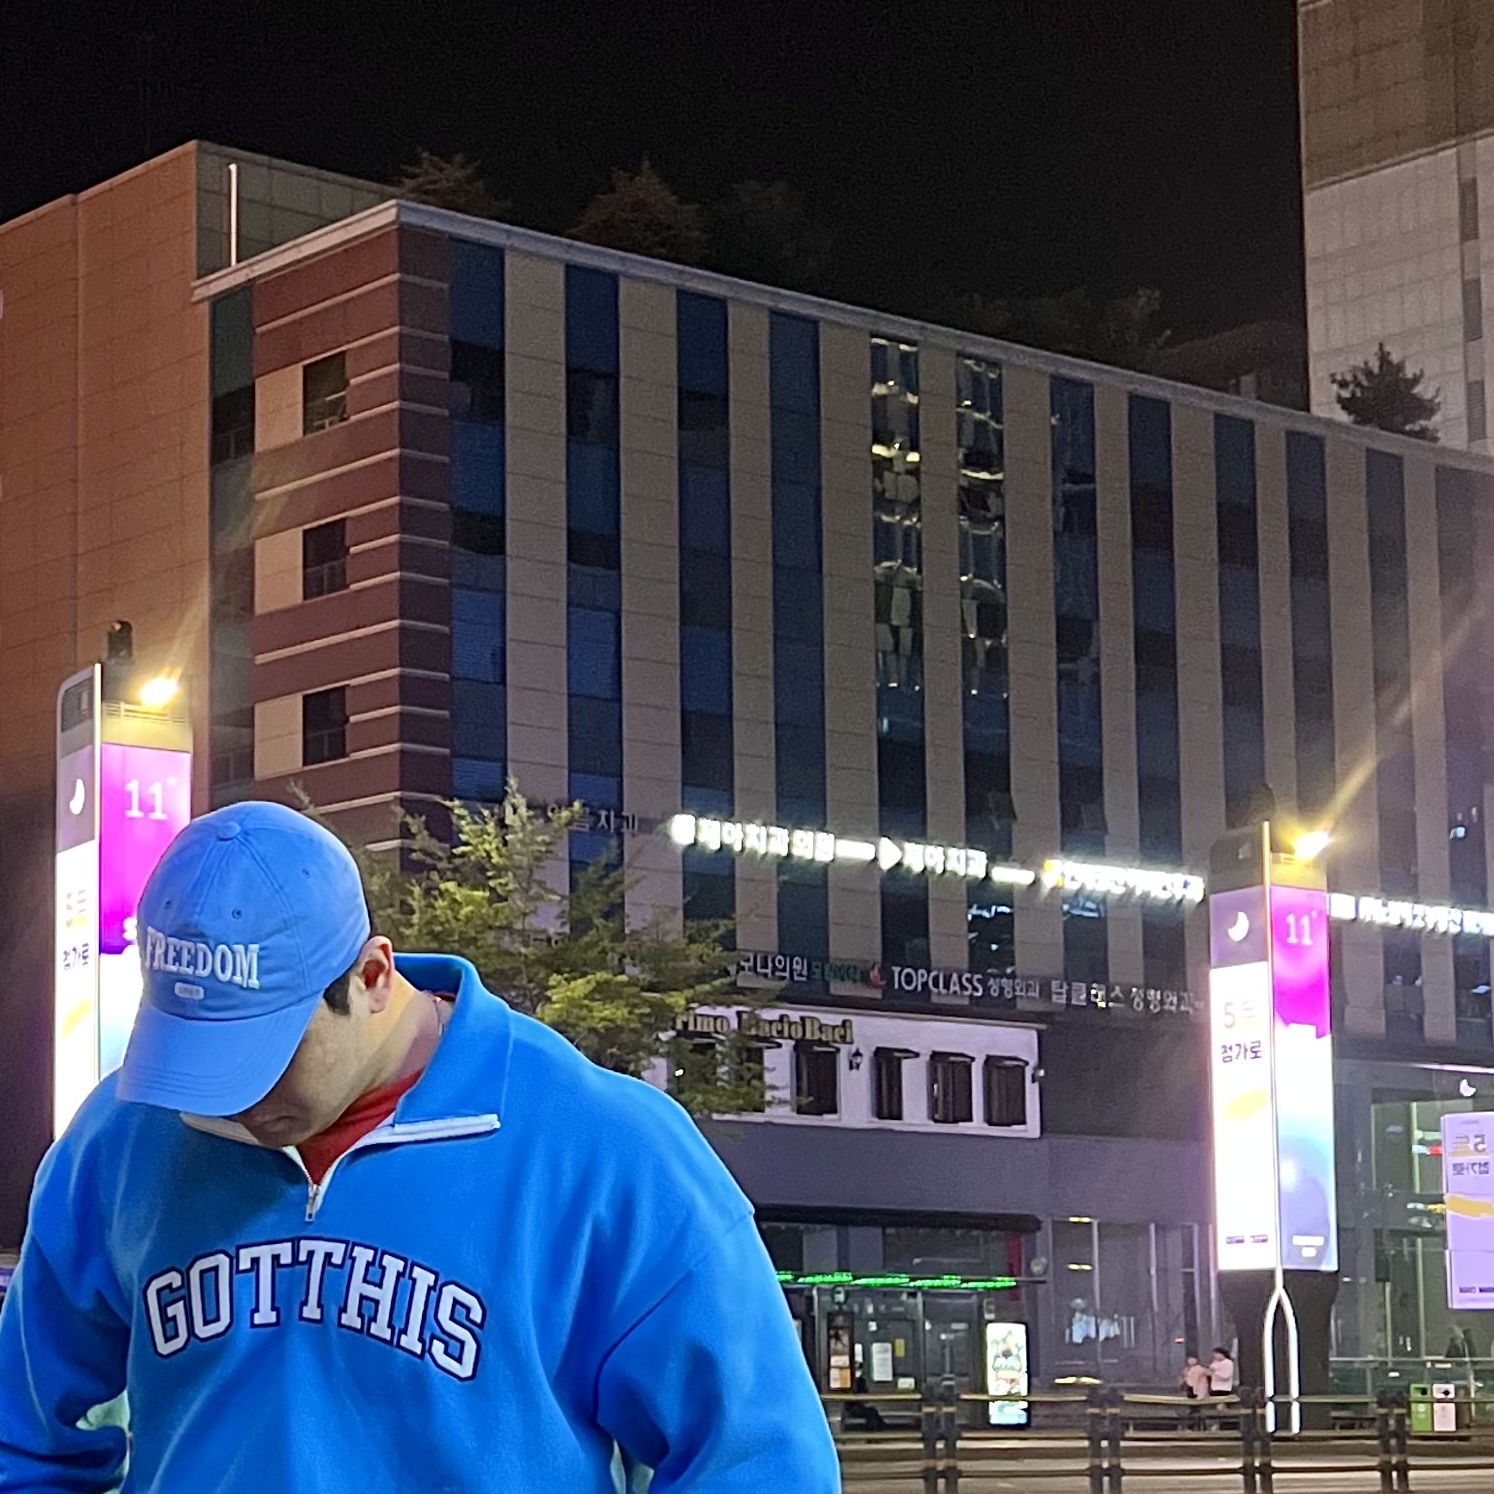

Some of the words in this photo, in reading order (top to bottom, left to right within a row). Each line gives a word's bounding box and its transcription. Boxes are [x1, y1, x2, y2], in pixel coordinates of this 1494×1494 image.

[145, 925, 261, 990] FREEDOM
[891, 965, 983, 997] TOPCLASS
[143, 1234, 488, 1383] GOTTHIS
